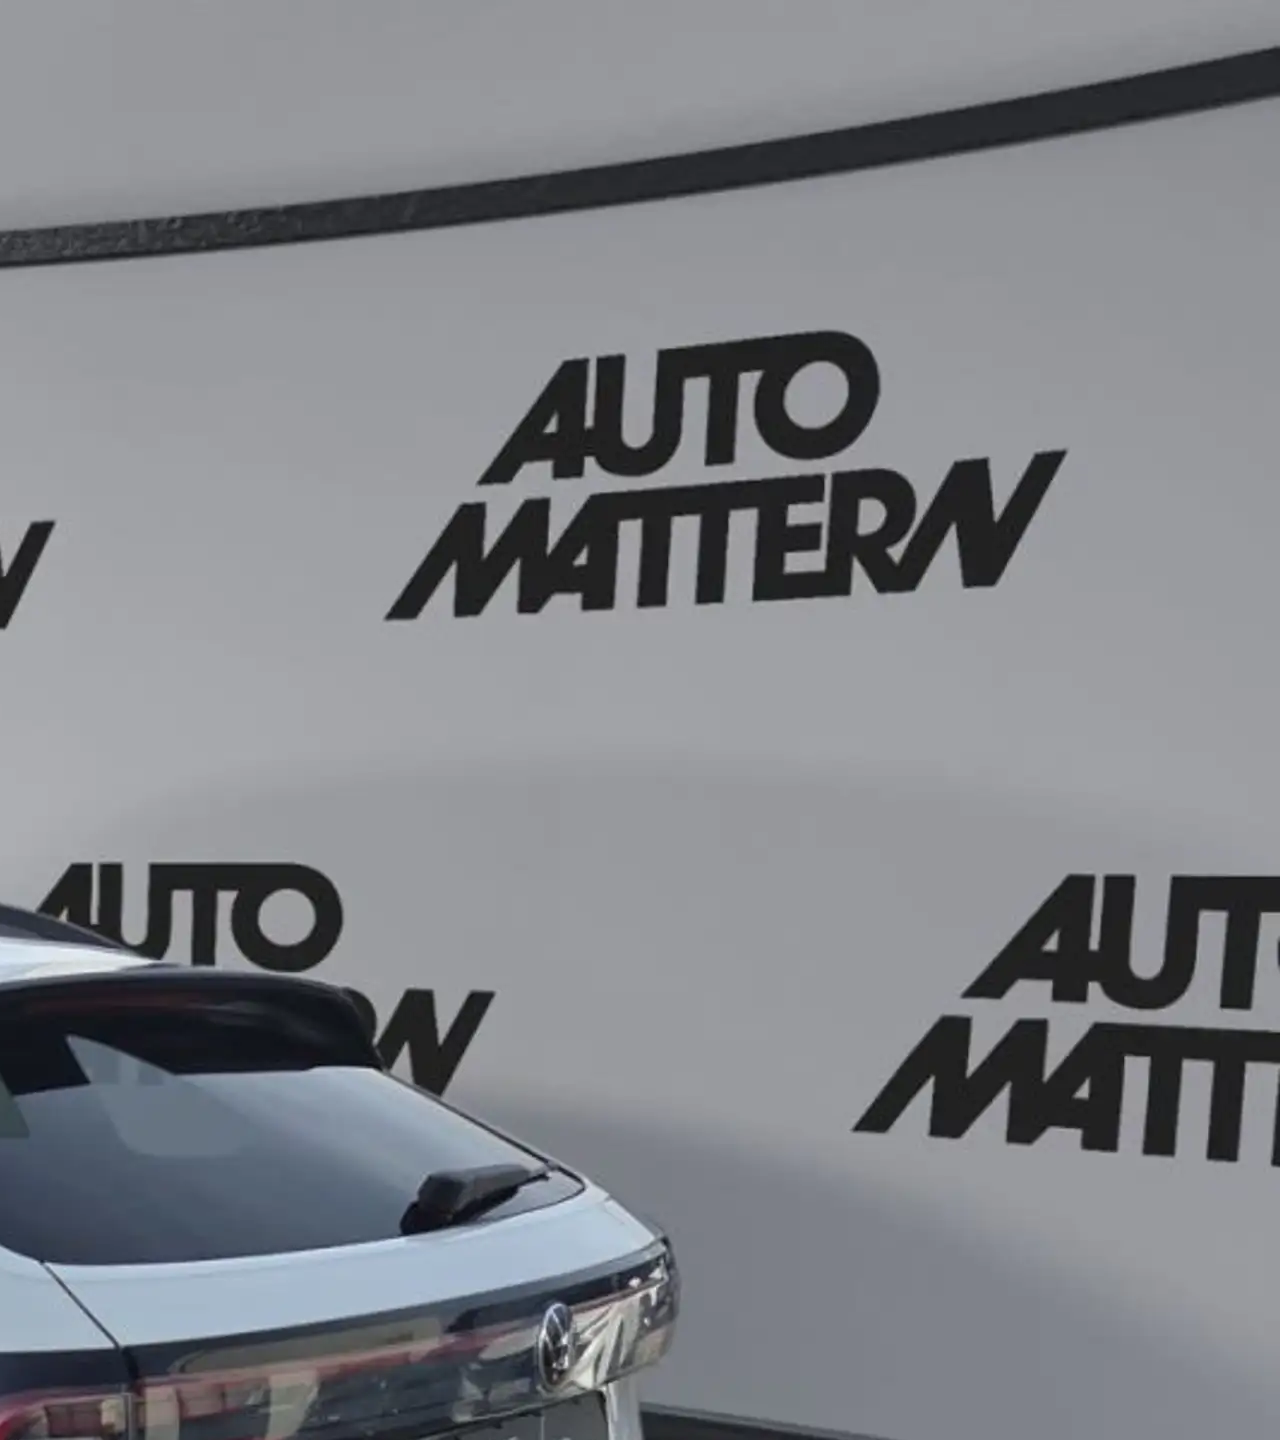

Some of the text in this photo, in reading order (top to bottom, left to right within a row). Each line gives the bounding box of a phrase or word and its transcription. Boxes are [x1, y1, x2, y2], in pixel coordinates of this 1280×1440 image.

[477, 330, 880, 486] AUTO
[385, 450, 1067, 621] MATTERN
[961, 874, 1280, 1010] AUT
[852, 1015, 1280, 1167] MATT
